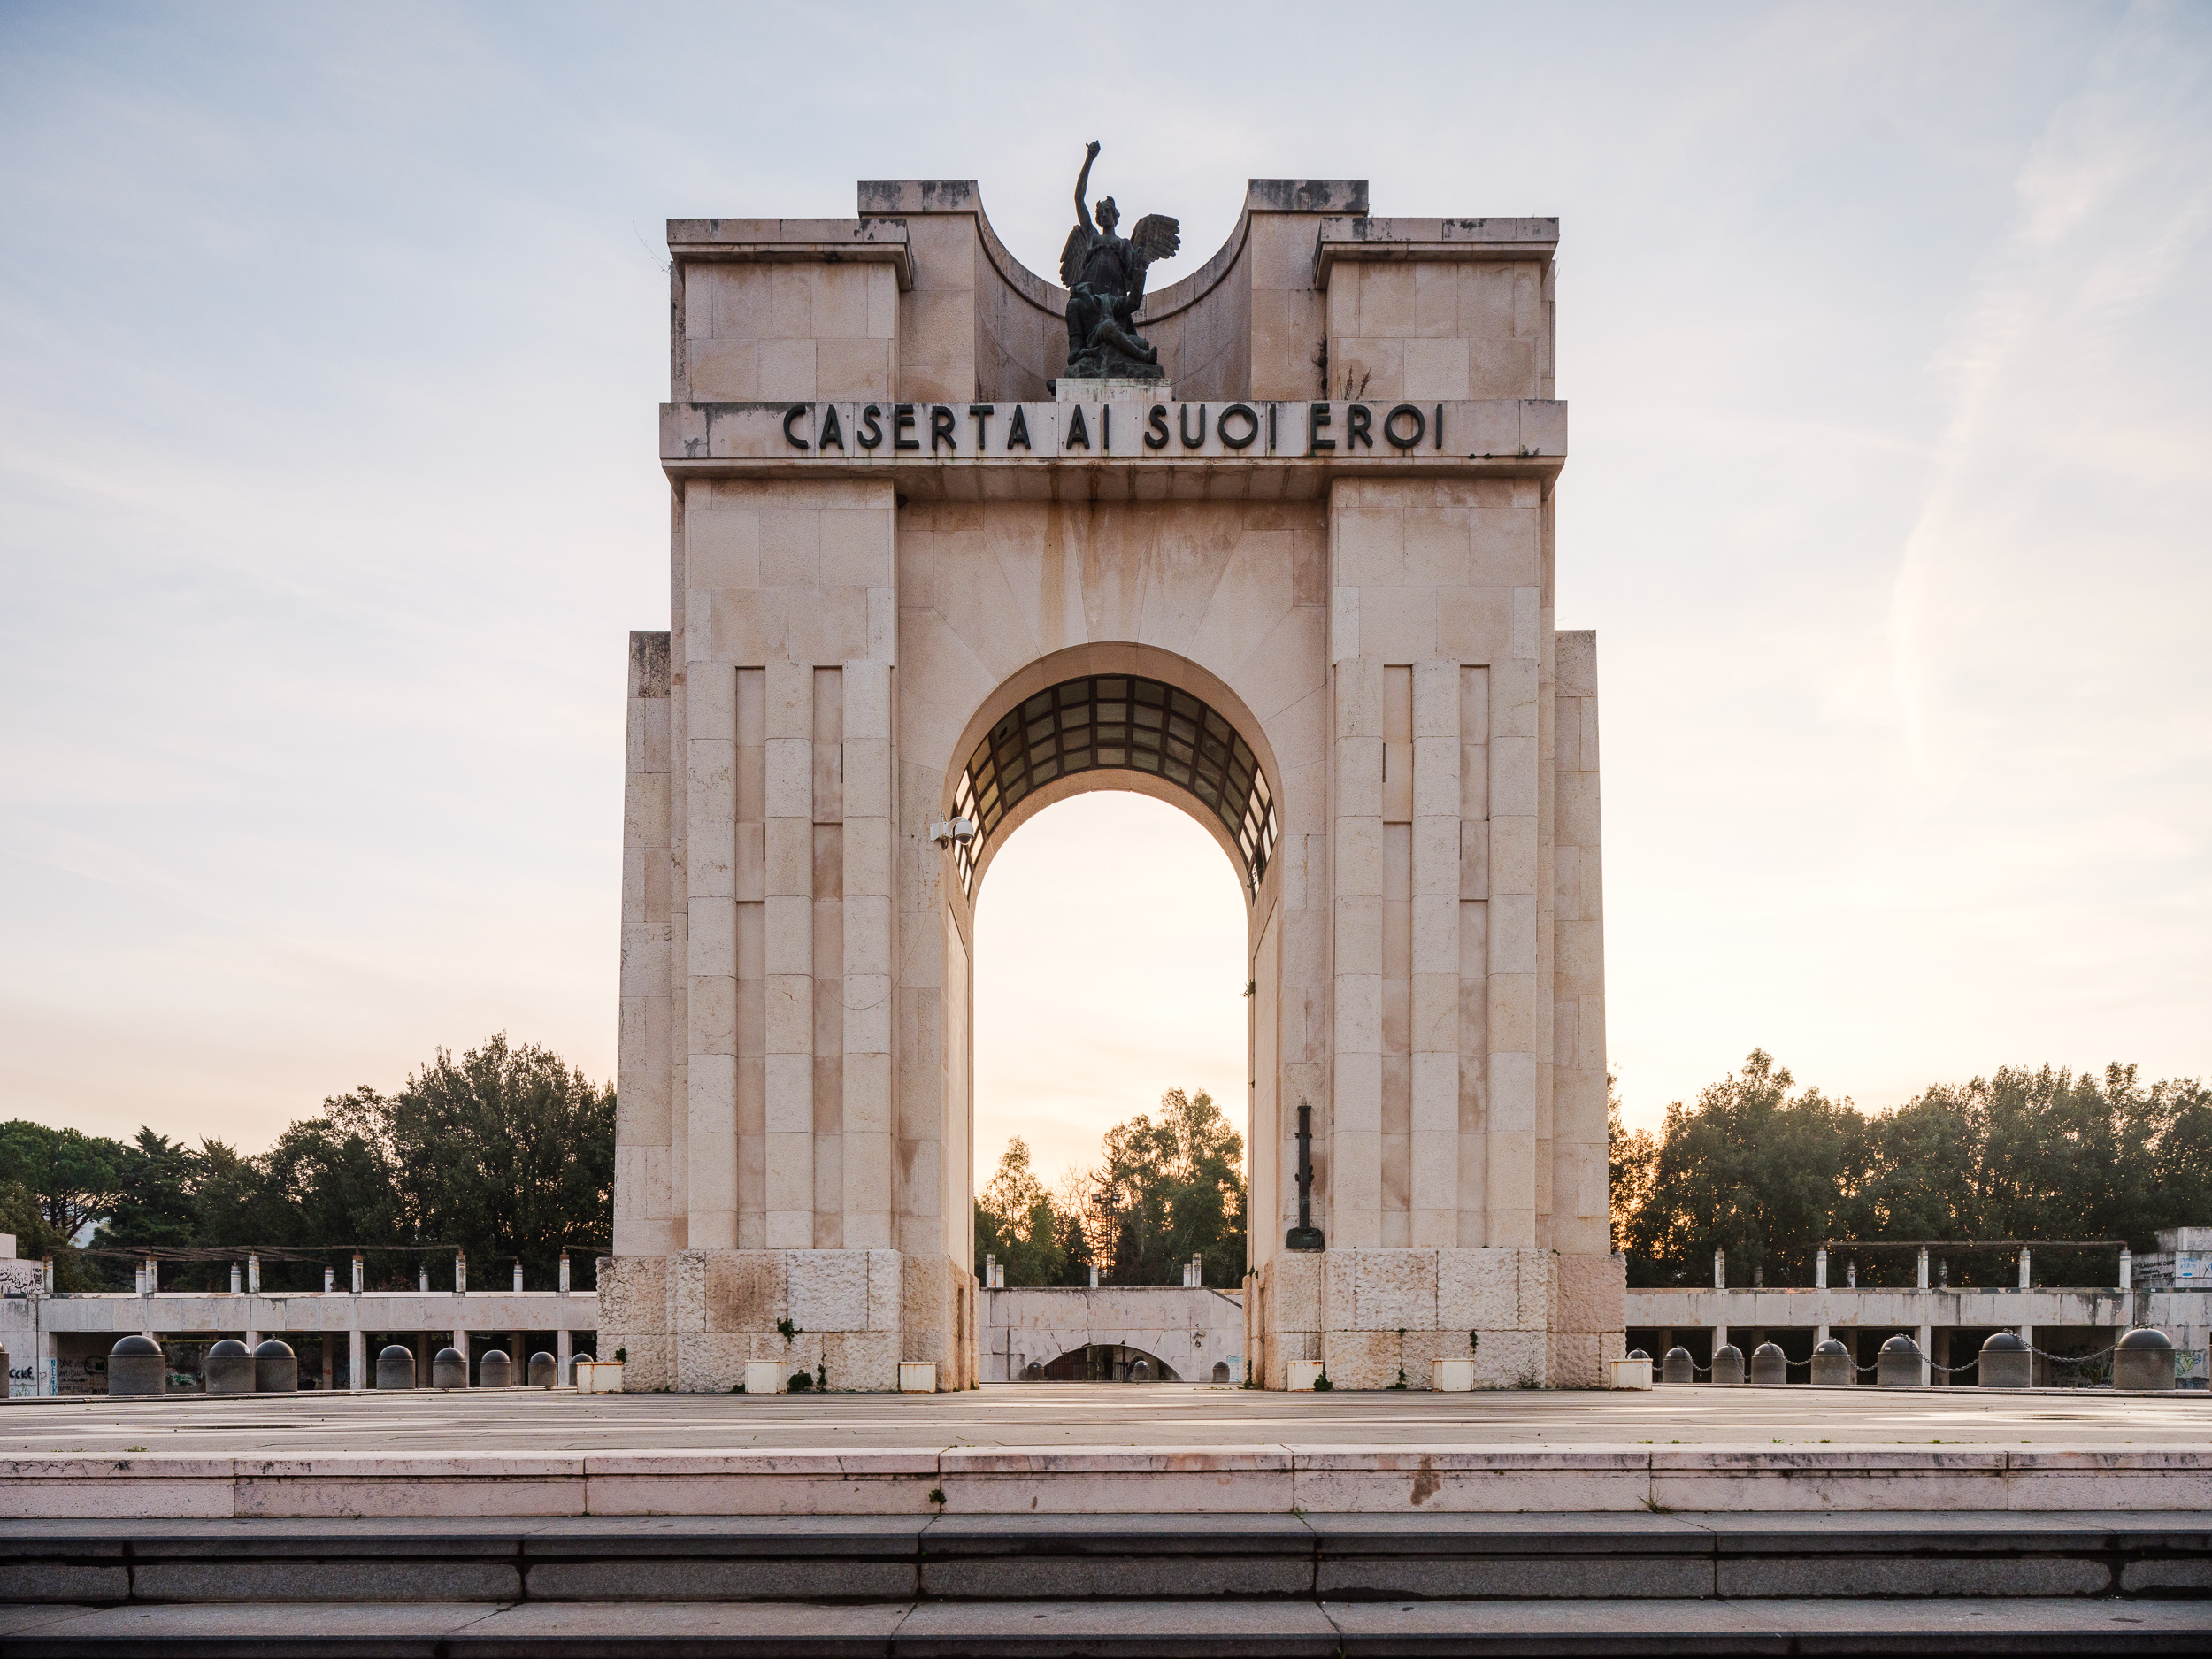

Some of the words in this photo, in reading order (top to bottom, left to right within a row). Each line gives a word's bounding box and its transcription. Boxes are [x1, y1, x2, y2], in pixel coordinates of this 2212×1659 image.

[783, 404, 1032, 449] CASERTA
[1066, 404, 1110, 449] AI
[1144, 404, 1277, 449] SUOI
[1310, 403, 1443, 449] EROI
